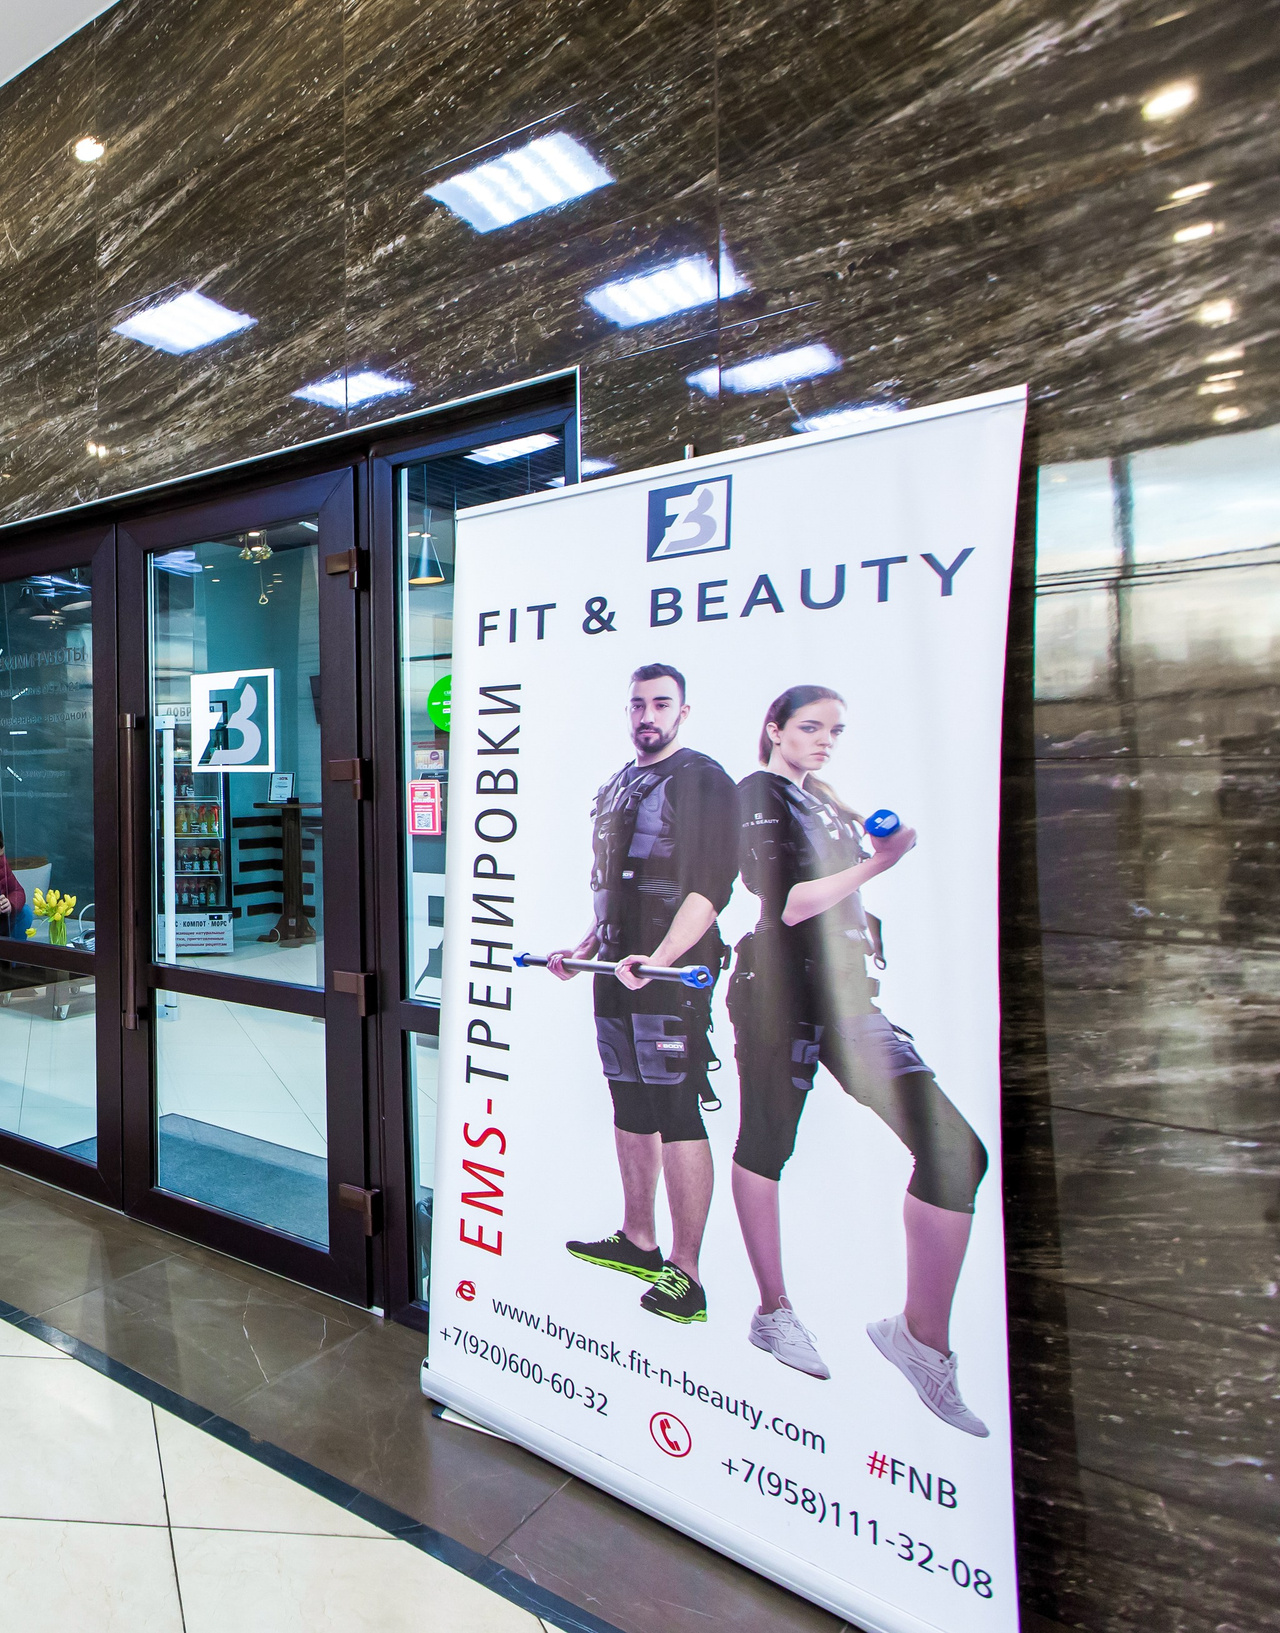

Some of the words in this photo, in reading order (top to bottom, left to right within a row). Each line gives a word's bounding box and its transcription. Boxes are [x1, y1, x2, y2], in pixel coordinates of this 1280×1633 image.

[477, 602, 557, 647] FIT
[581, 595, 618, 636] &
[650, 546, 977, 628] BEAUTY
[439, 1327, 609, 1417] +7(920)600-60-32
[491, 1297, 827, 1455] www.bryansk.fit-n-beauty.com
[720, 1457, 995, 1600] +7(958)111-32-08
[866, 1450, 959, 1510] #FNB
